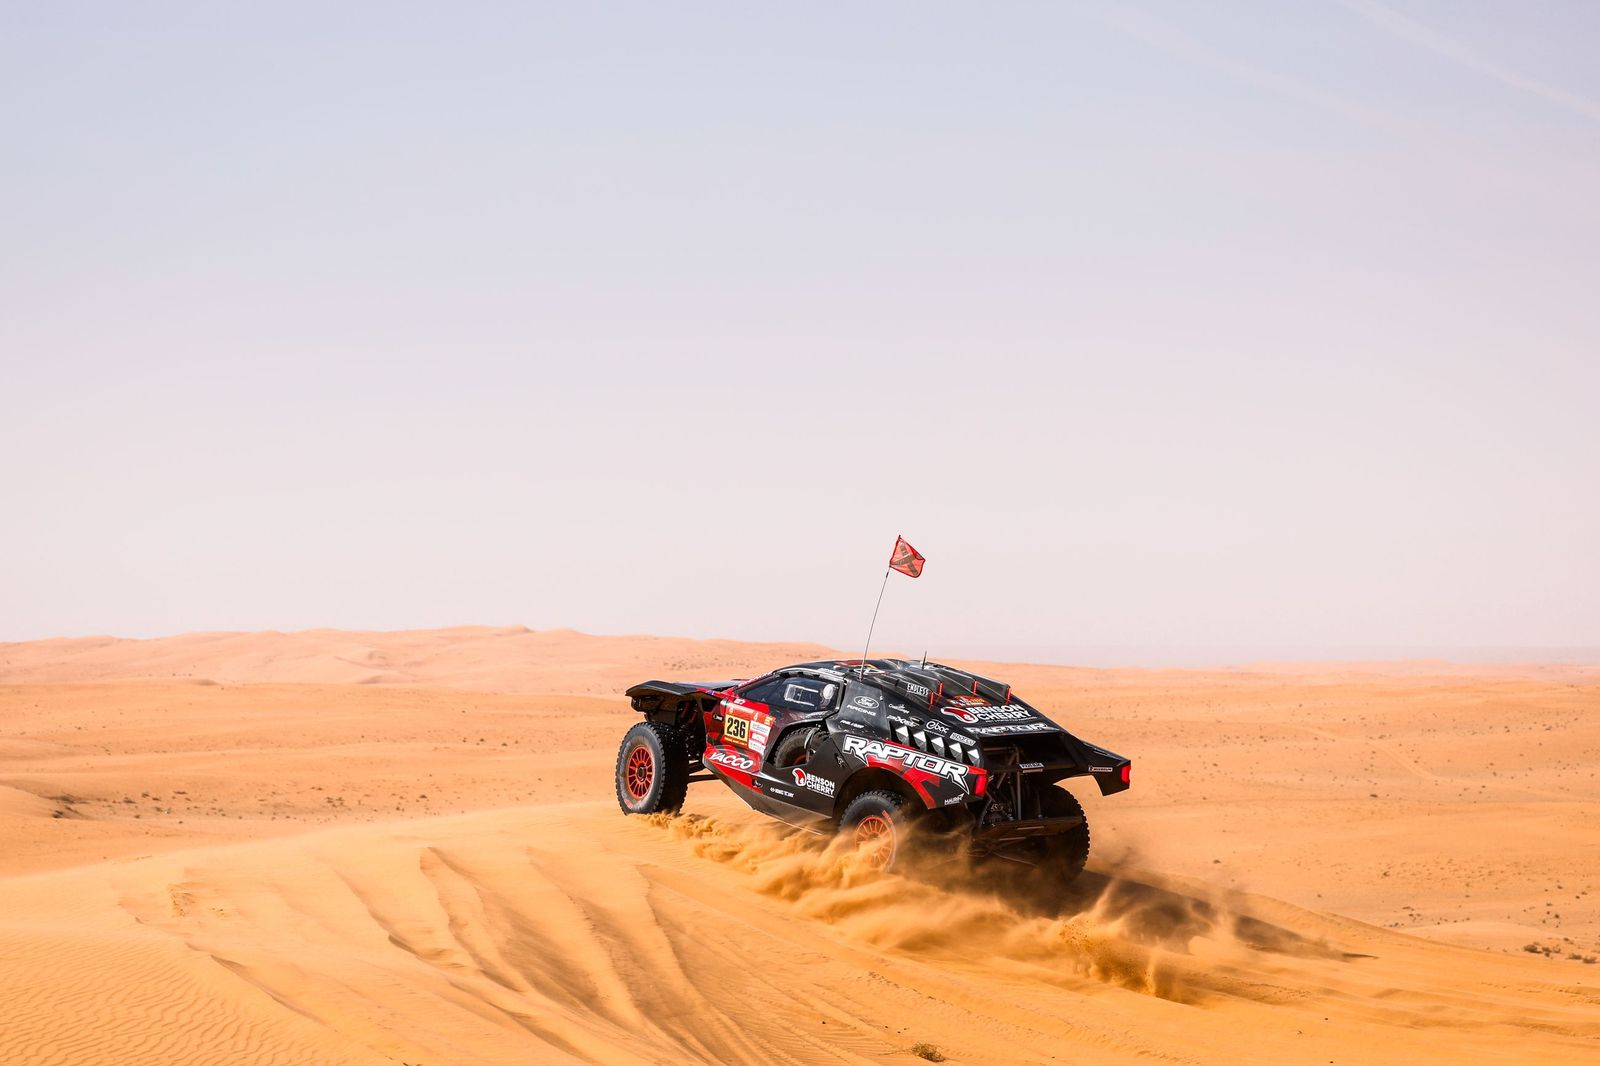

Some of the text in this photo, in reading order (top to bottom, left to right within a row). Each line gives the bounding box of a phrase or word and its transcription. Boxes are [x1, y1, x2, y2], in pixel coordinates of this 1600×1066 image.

[906, 682, 929, 696] ENDLESS
[857, 696, 876, 707] Ford
[846, 704, 877, 716] RACING
[966, 704, 1025, 714] BENSON
[976, 710, 1031, 721] CHERRY
[726, 716, 746, 739] 236
[964, 723, 1059, 736] RAPTOR
[709, 752, 754, 769] YACCO
[842, 734, 970, 795] RAPTOR
[806, 772, 835, 789] BENSON
[806, 780, 835, 796] CHERRY
